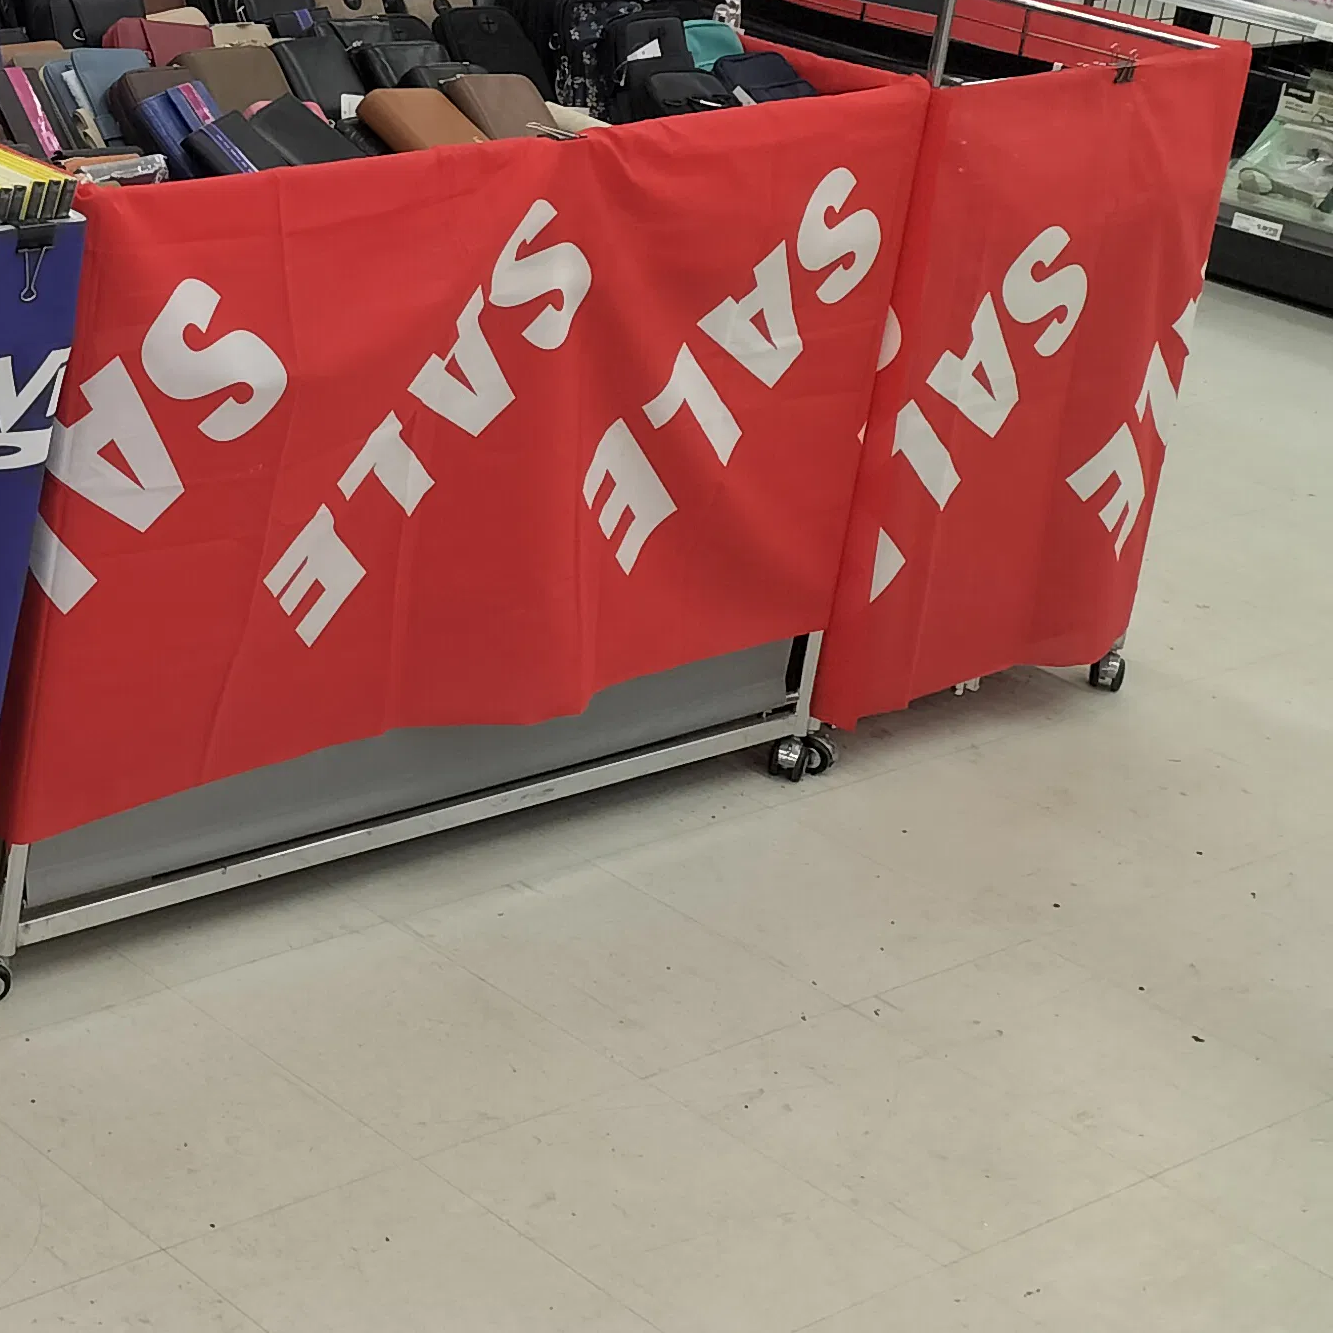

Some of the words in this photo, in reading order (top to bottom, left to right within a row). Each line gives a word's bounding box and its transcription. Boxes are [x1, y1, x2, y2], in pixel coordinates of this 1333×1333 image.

[263, 198, 593, 648] SALE
[583, 166, 882, 576] SALE
[870, 223, 1090, 603] SAL
